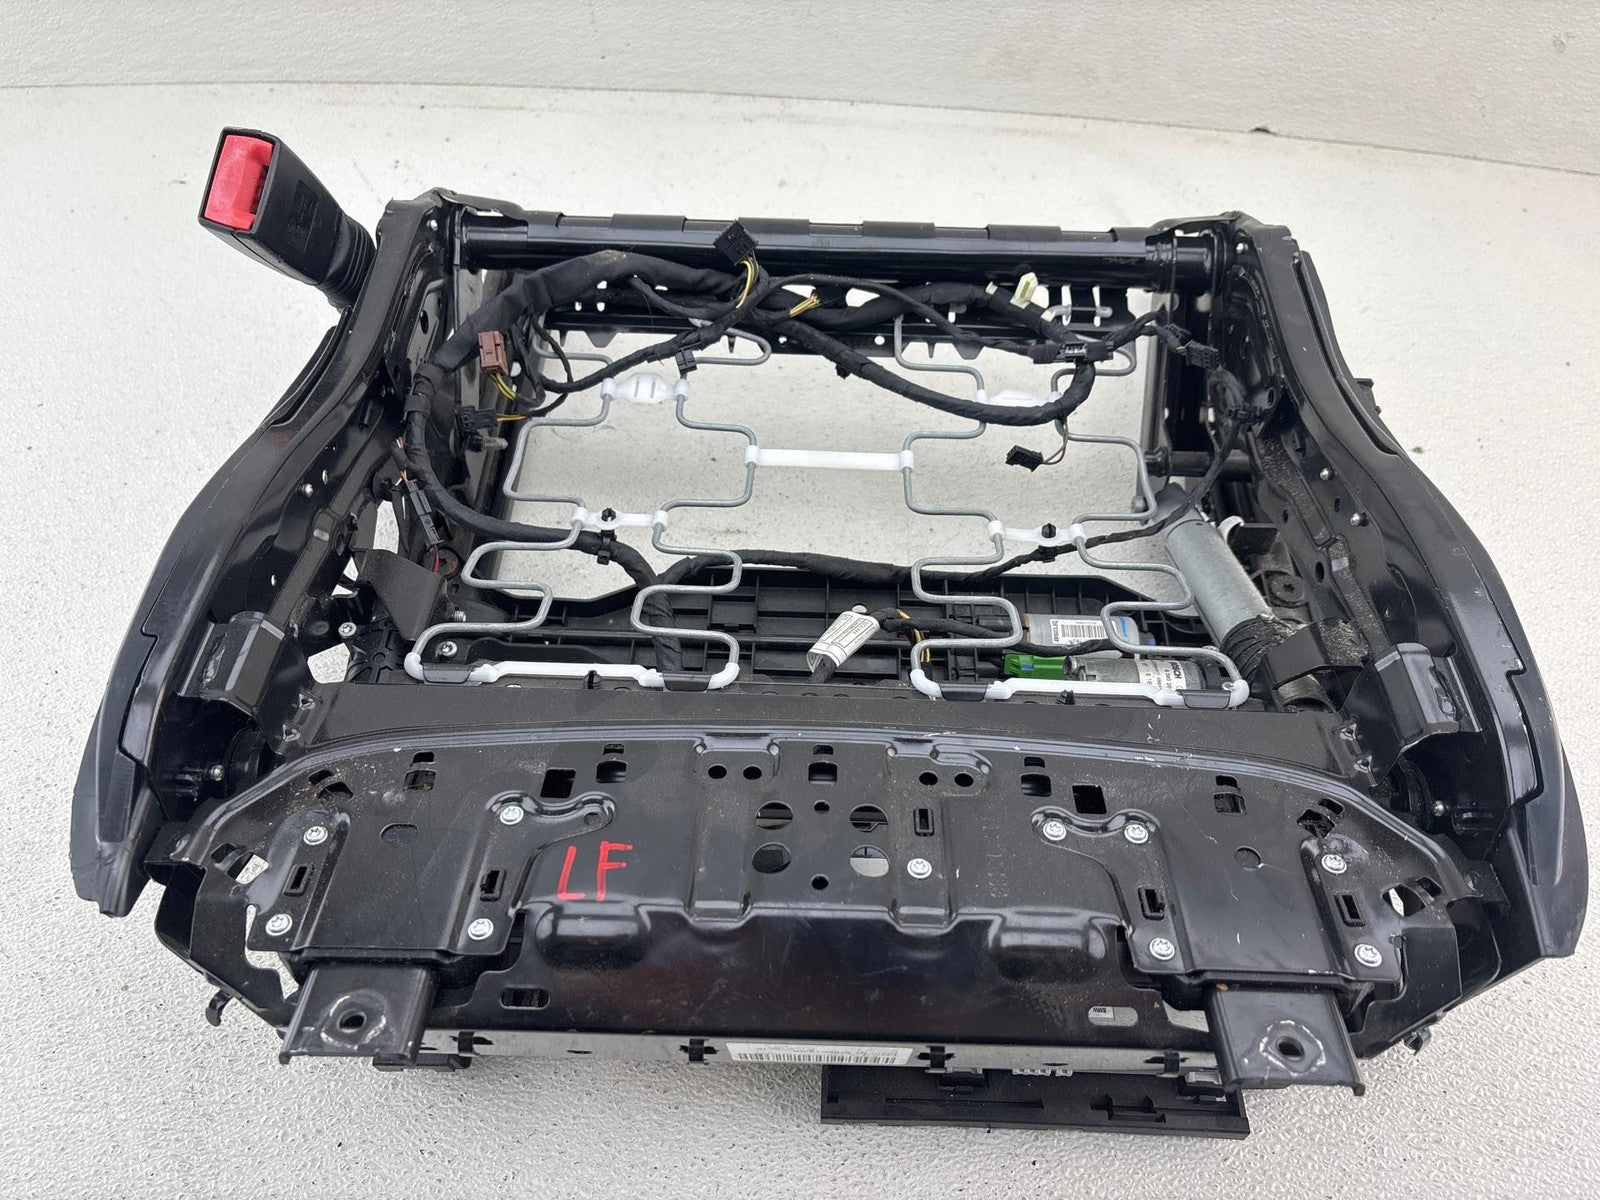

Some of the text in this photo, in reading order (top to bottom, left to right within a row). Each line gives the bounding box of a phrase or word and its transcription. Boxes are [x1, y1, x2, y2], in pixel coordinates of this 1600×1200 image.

[1052, 620, 1060, 642] brose
[1169, 661, 1183, 679] BOSCH
[557, 841, 633, 902] LF
